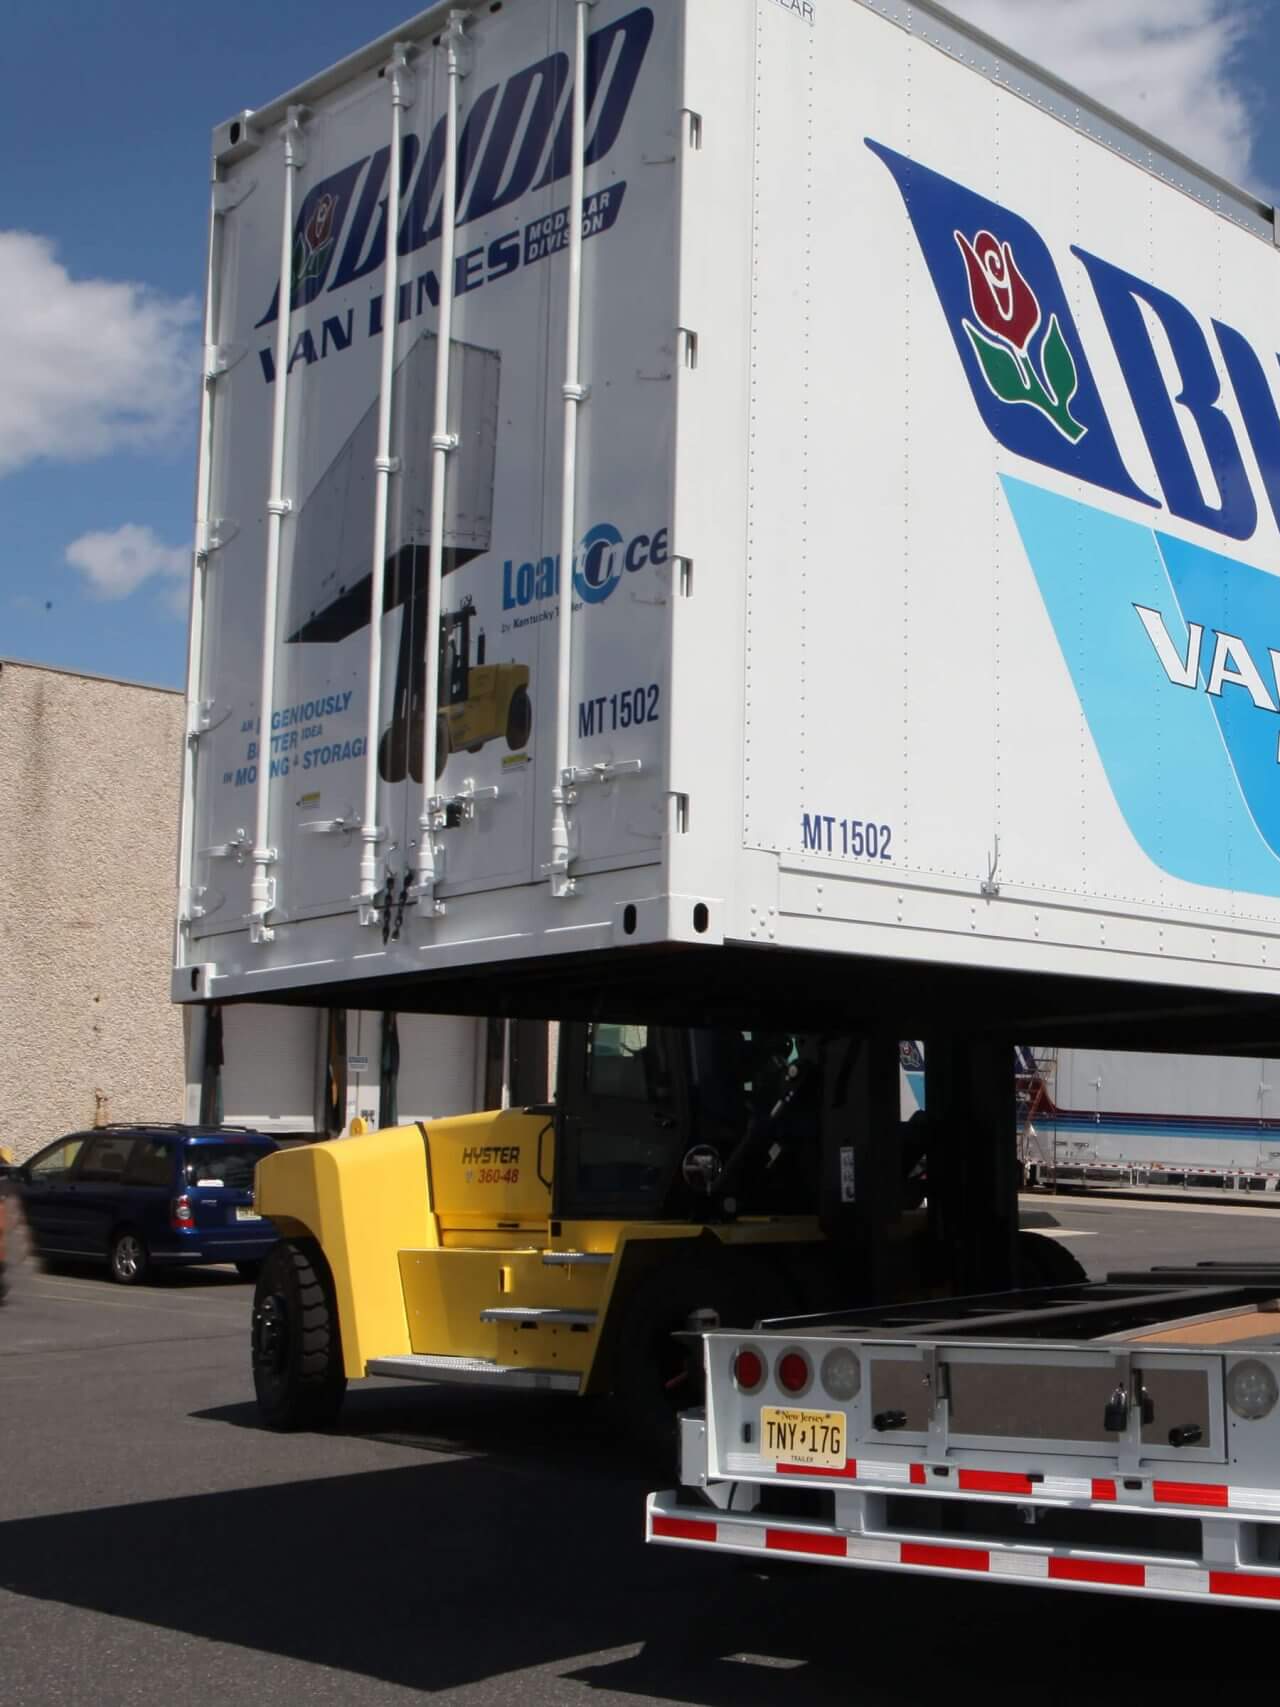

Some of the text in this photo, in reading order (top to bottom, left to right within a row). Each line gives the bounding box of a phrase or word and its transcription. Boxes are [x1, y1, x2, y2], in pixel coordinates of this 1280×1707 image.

[529, 192, 610, 242] MODAR
[528, 214, 604, 261] DIVISON
[256, 691, 352, 734] IGENIOUSLY
[578, 684, 659, 739] MT1502
[235, 758, 289, 787] MONG
[803, 813, 892, 860] MT1502
[462, 1146, 520, 1165] HYSTER
[767, 1421, 797, 1450] TNY
[782, 1411, 824, 1424] New Jersey
[791, 1455, 814, 1463] TRAILER
